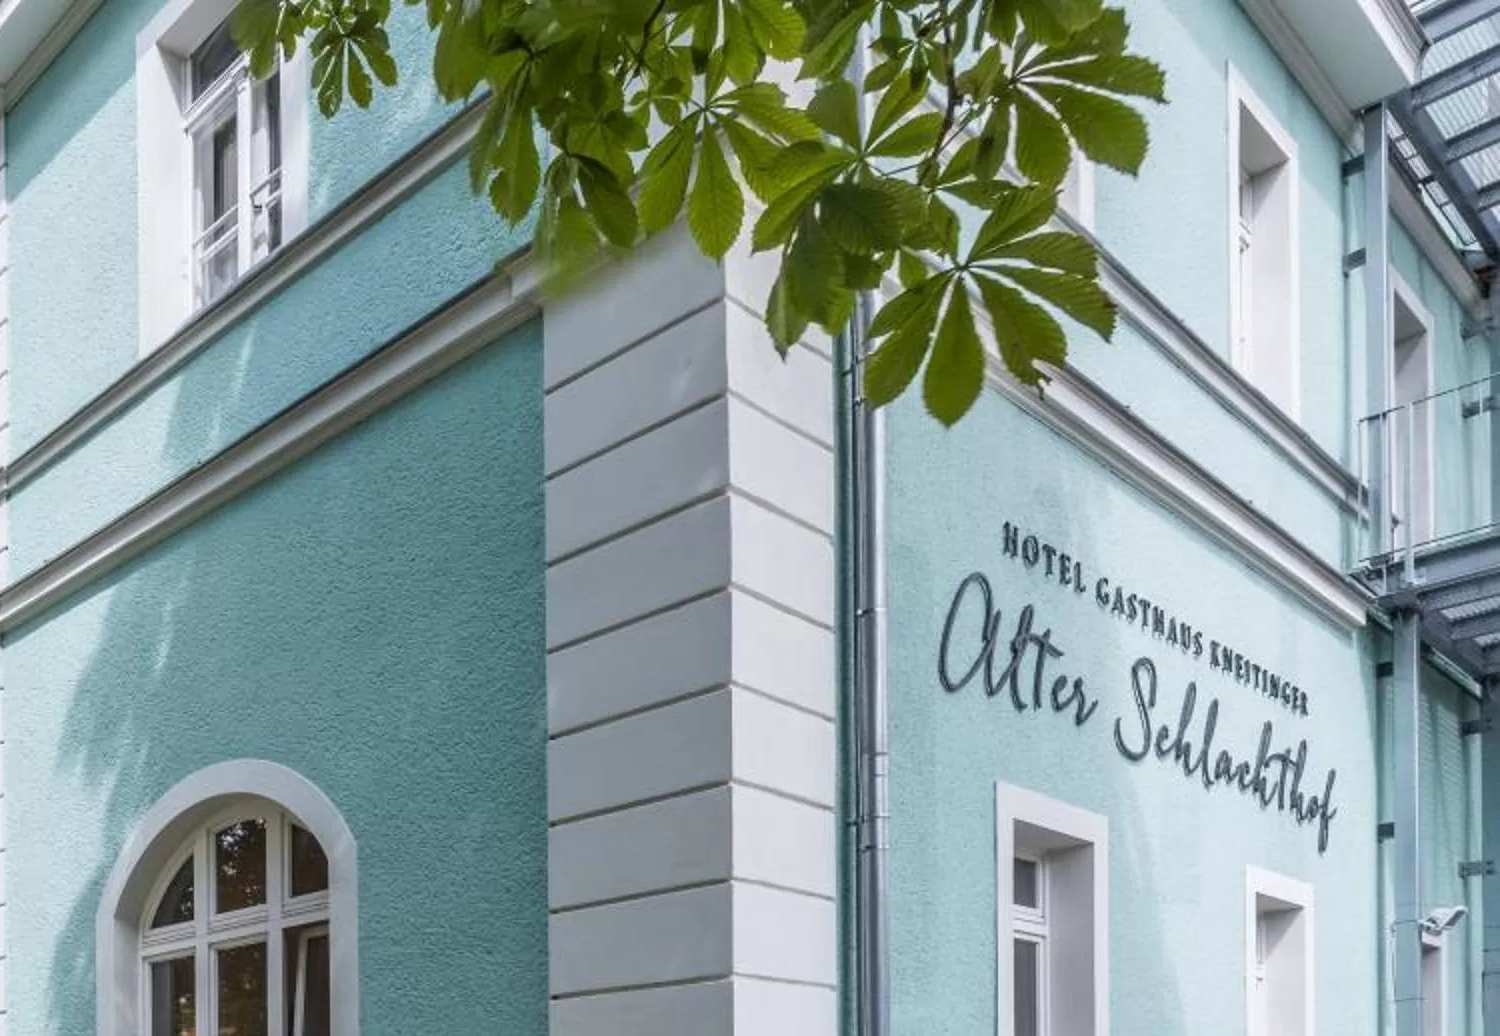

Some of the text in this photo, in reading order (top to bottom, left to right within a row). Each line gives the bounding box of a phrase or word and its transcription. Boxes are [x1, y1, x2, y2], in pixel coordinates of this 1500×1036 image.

[938, 571, 1337, 853] Alter Schlachthof
[1002, 521, 1309, 716] HOTEL GASTHAUS KNEITINGER
